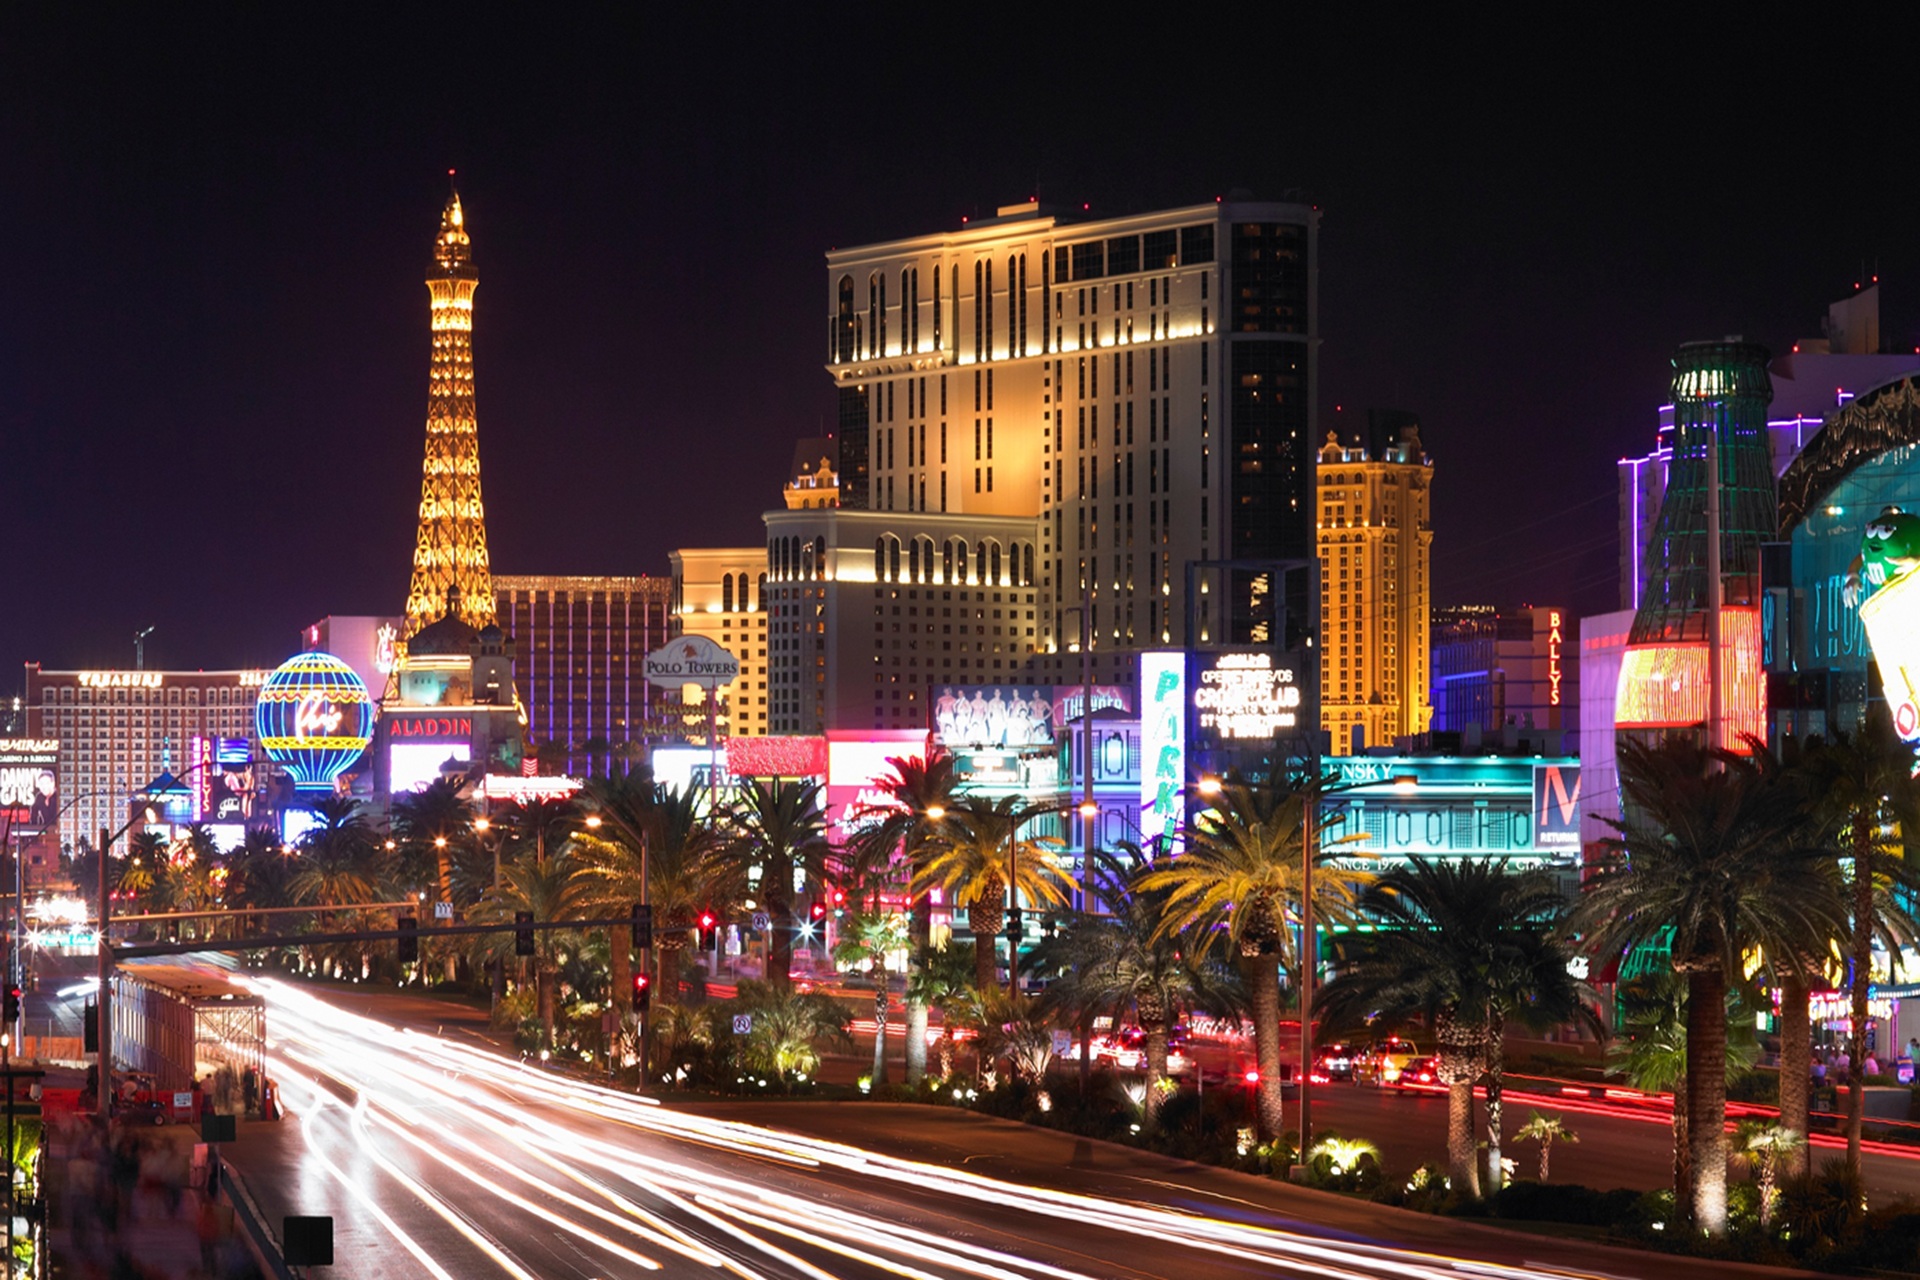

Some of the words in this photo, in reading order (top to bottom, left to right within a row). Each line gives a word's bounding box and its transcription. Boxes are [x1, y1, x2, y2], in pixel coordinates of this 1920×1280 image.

[646, 661, 682, 674] POLO
[685, 660, 737, 674] TOWERS
[1549, 612, 1562, 705] BALLYS
[78, 673, 164, 688] TREASURE
[655, 699, 732, 716] Hawaiin
[390, 719, 471, 737] ALADDIN
[202, 740, 211, 812] BALLYS
[1330, 858, 1370, 871] SINCE
